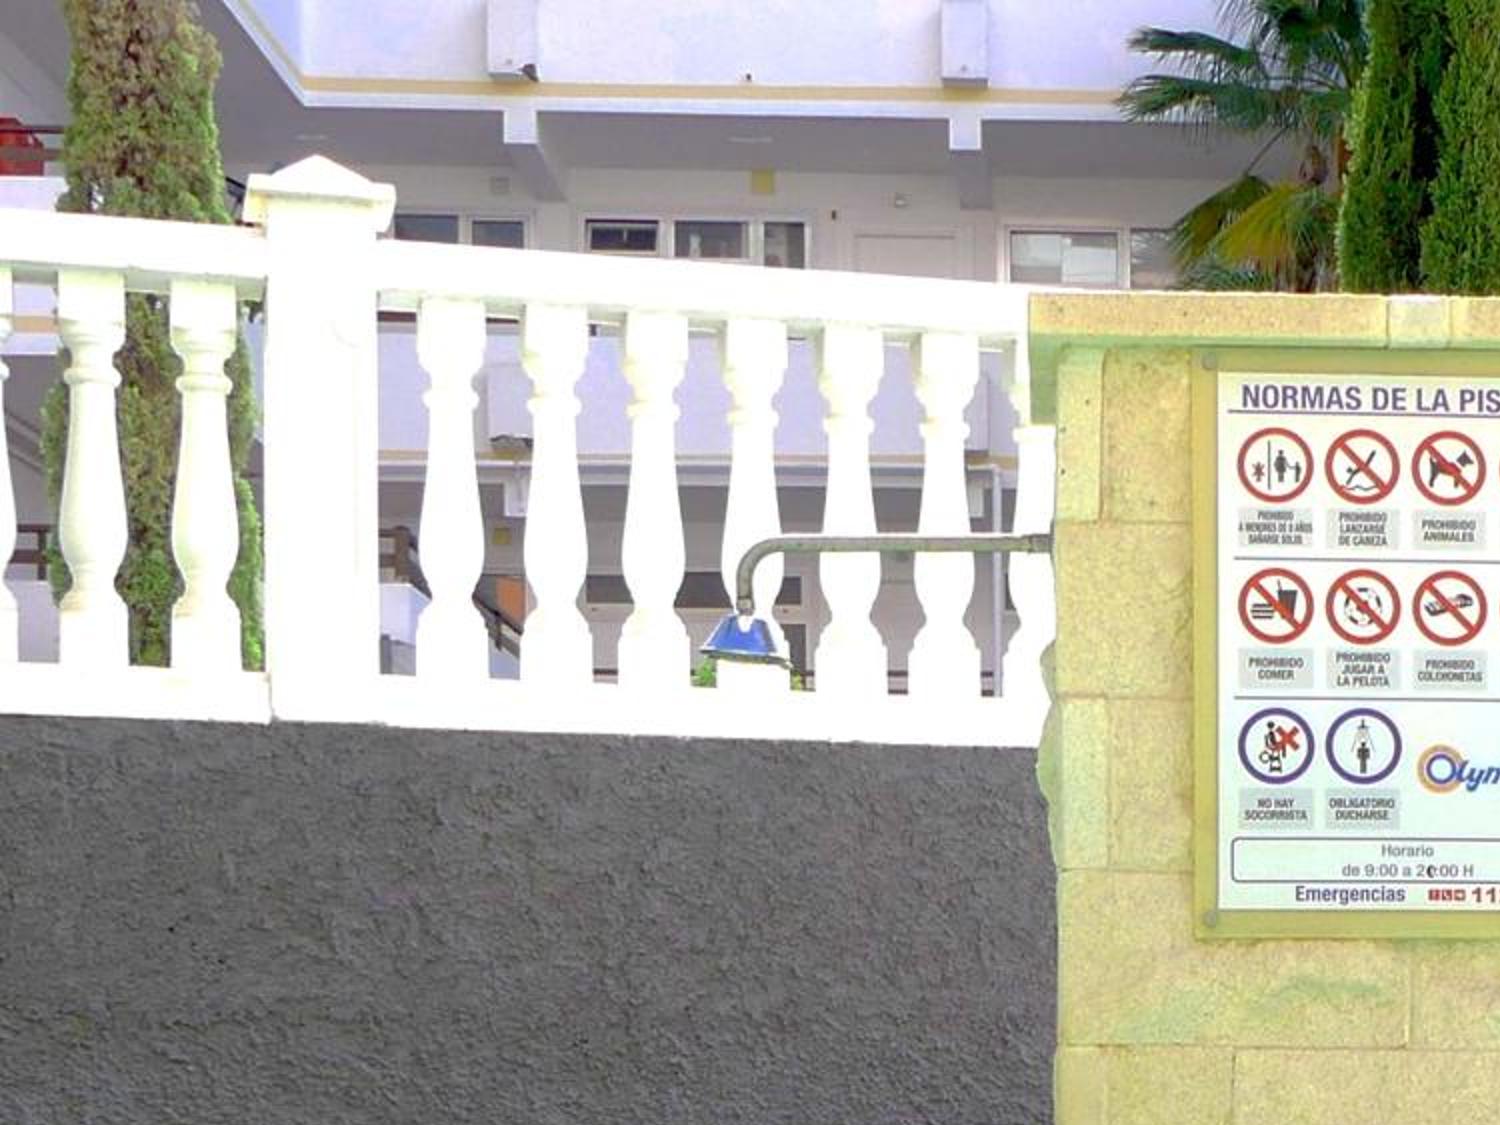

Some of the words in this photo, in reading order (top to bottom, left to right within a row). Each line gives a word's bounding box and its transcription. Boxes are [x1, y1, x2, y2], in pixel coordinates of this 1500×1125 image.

[1241, 384, 1361, 411] NORMAS
[1372, 388, 1407, 412] DE
[1416, 388, 1451, 412] LA
[1339, 512, 1387, 522] PROHIBIDO
[1340, 524, 1385, 533] LANZARSE
[1422, 520, 1476, 530] PROHIBIDO
[1339, 536, 1350, 545] DE
[1353, 536, 1387, 546] CABEZA
[1424, 532, 1474, 542] ANIMALES
[1248, 657, 1304, 668] PROHIBIDO
[1336, 653, 1391, 663] PROHIBIDO
[1342, 664, 1375, 674] JUGAR
[1378, 664, 1384, 674] A
[1426, 660, 1475, 669] PROHIBIDO
[1258, 670, 1294, 679] COMER
[1418, 672, 1482, 682] COLCHONETAS
[1337, 676, 1349, 686] LA
[1352, 677, 1389, 687] PELOTA
[1257, 798, 1272, 808] NO
[1275, 798, 1295, 808] HAY
[1329, 798, 1395, 808] OBLIGATORIO
[1245, 810, 1307, 820] SOCORRISTA
[1335, 810, 1389, 820] DUCHARSE
[1382, 845, 1434, 857] Horario
[1342, 864, 1360, 876] de
[1365, 864, 1398, 876] 9:00
[1402, 867, 1411, 876] a
[1463, 865, 1474, 876] H
[1296, 886, 1405, 905] Emergencias
